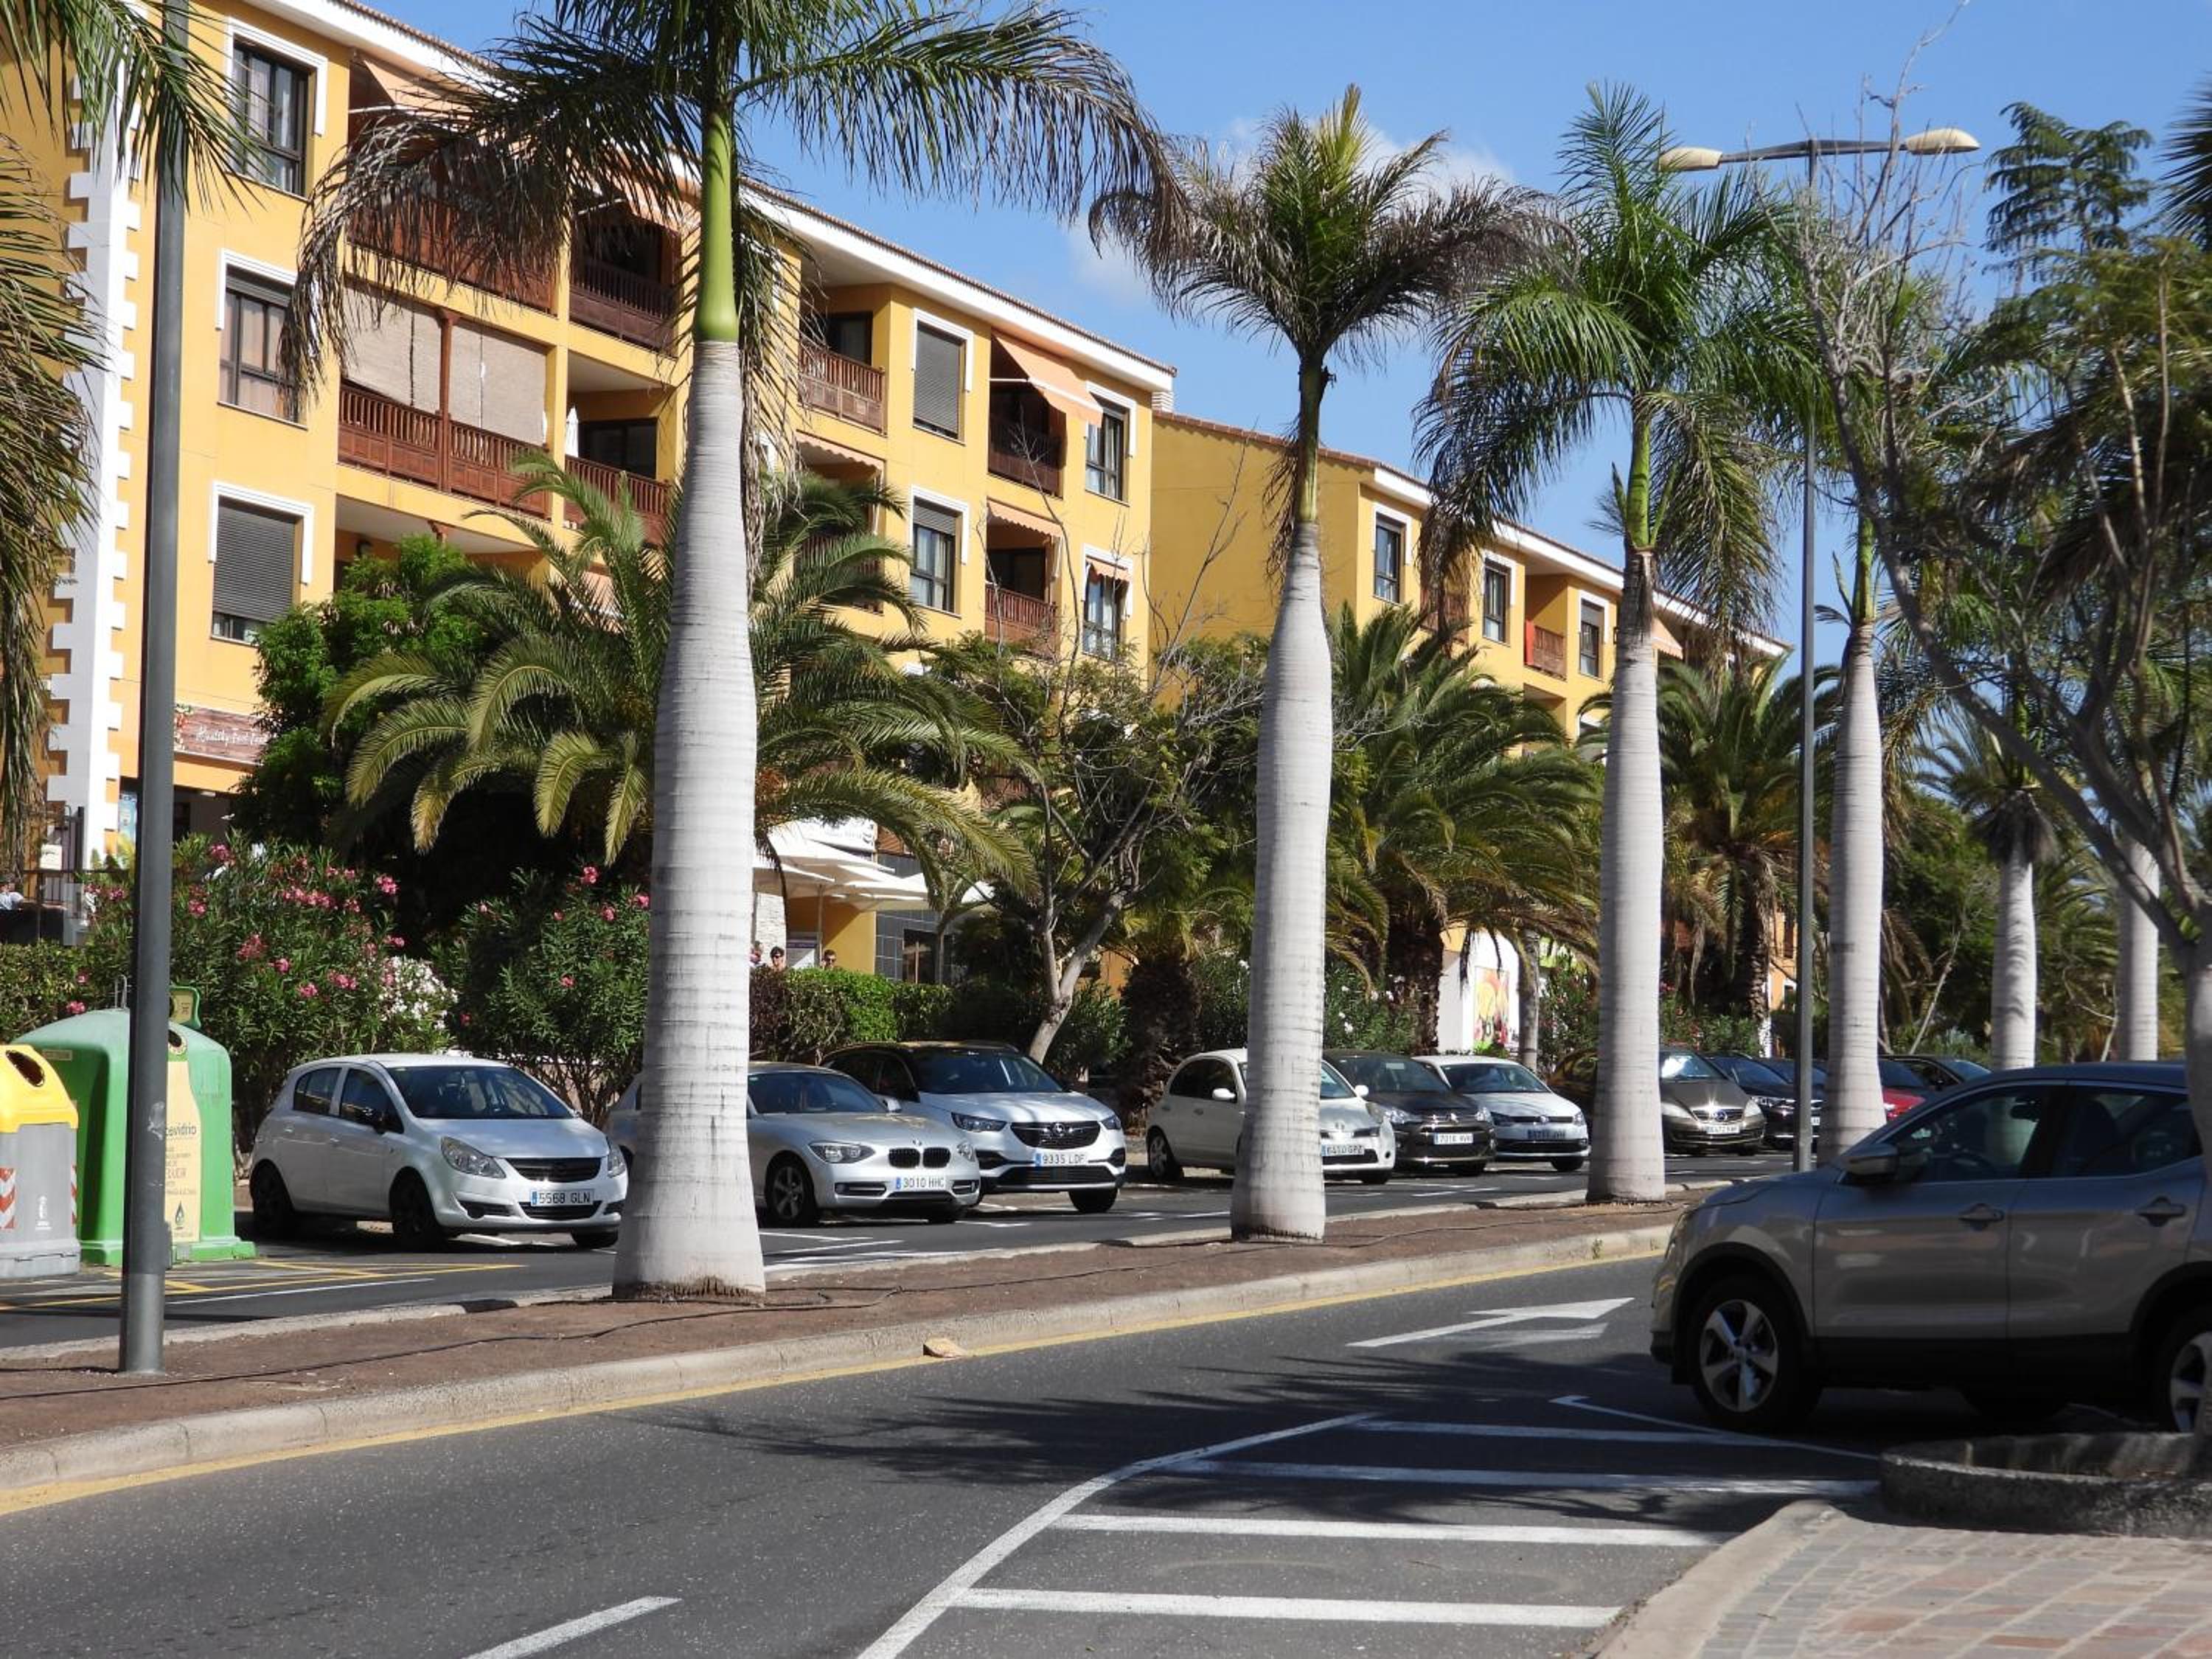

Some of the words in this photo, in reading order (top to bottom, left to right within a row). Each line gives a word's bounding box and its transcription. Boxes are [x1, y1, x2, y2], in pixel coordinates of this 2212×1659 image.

[1043, 1154, 1065, 1164] 9335
[903, 1177, 926, 1188] 3010
[538, 1192, 566, 1204] 5568
[570, 1191, 591, 1204] GLN
